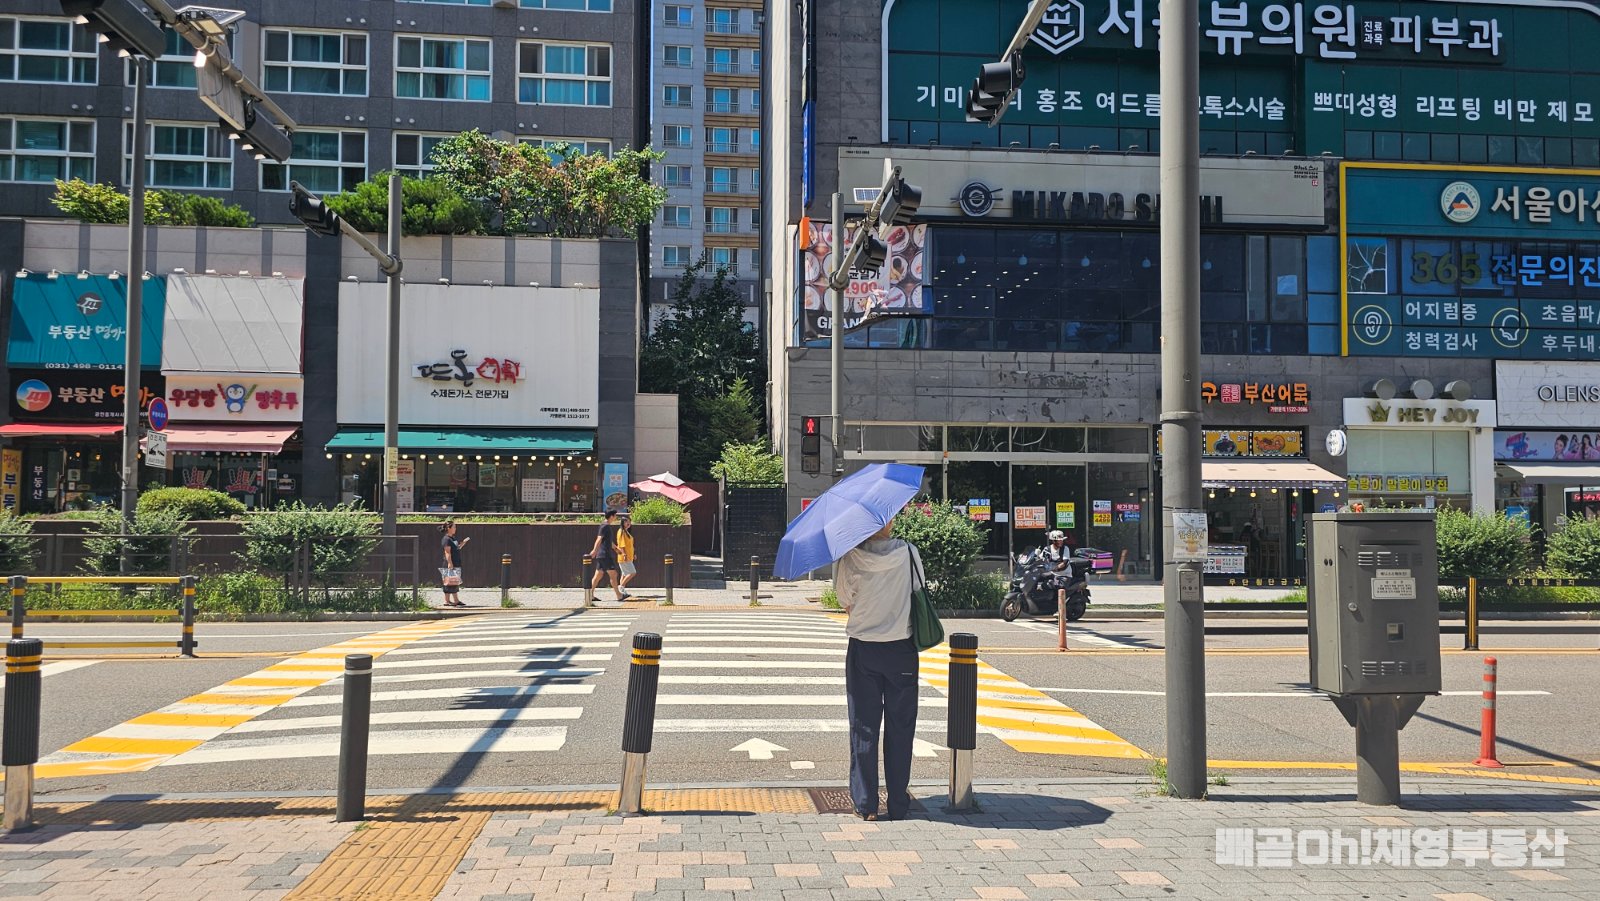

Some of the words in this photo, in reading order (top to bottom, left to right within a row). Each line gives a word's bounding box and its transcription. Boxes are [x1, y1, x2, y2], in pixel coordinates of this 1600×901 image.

[1097, 0, 1357, 59] 서뷰의원
[1363, 20, 1383, 33] 진료
[1390, 15, 1503, 56] 피부과
[1363, 33, 1384, 46] 과목
[916, 85, 963, 109] 기미
[1036, 88, 1083, 113] 홍조
[1199, 96, 1286, 120] 톡스시술
[1313, 92, 1397, 118] 쁘띠성형
[1416, 96, 1481, 121] 리프팅
[1494, 99, 1536, 122] 비만
[1547, 101, 1594, 122] 제모
[1012, 191, 1125, 220] MIKADO
[1135, 193, 1223, 223] SHI
[1411, 253, 1481, 285] 365
[1405, 302, 1478, 321] 어지럼증
[48, 325, 92, 340] 부동산
[95, 324, 126, 341] 명가
[1405, 332, 1478, 351] 청력검사
[1542, 335, 1600, 354] 후두내
[58, 387, 105, 404] 부동산
[431, 389, 473, 399] 수제돈가스
[476, 389, 509, 399] 전문가집
[1245, 382, 1308, 405] 부산어묵
[1538, 385, 1600, 402] OLENS
[1398, 407, 1437, 422] HEY
[1443, 407, 1480, 423] JOY
[33, 465, 44, 500] 부동산
[1425, 478, 1448, 492] 맛집
[1016, 508, 1034, 519] 임대
